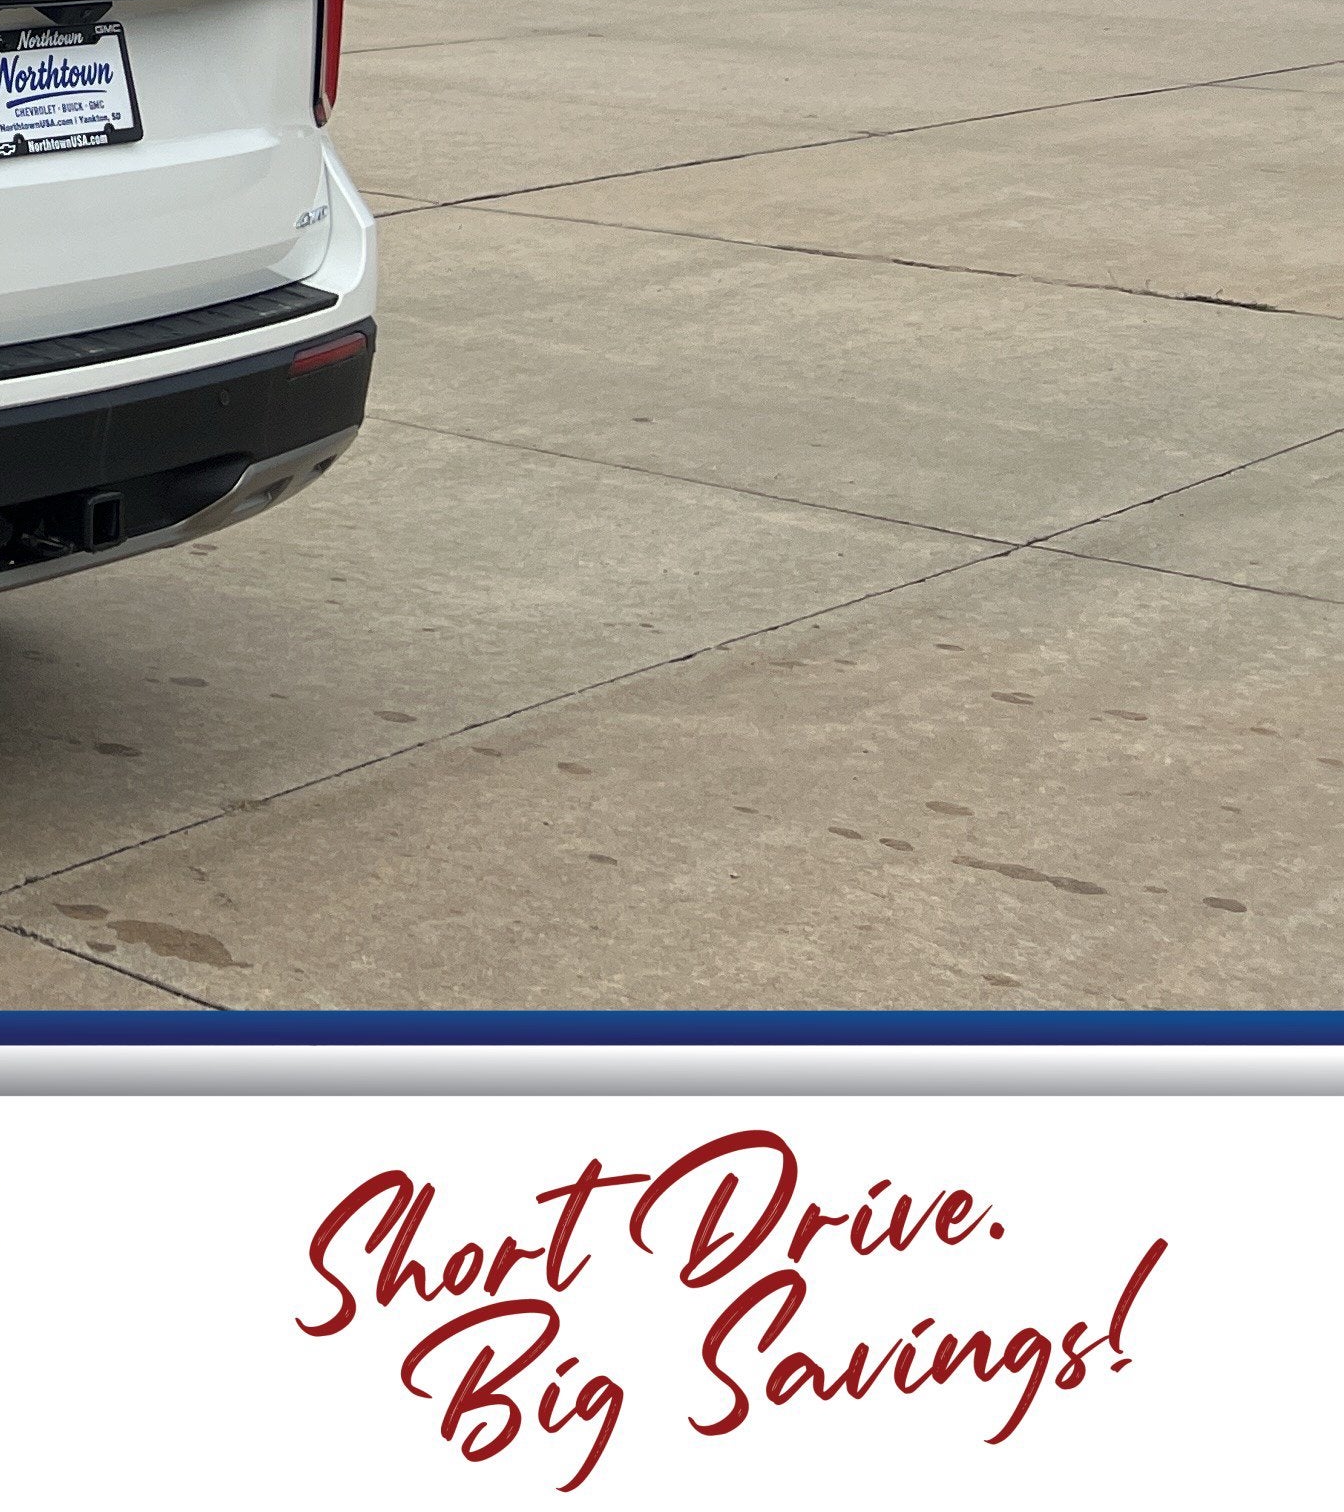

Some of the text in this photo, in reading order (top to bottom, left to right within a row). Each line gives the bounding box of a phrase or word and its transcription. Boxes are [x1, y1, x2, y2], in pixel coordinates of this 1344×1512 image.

[94, 24, 122, 34] GMC
[17, 30, 83, 51] Northtown
[14, 99, 105, 118] CHEVROLET BUICK GMC
[0, 118, 73, 132] NorthtownUSA.com
[28, 133, 109, 153] NorthtownUSA.com
